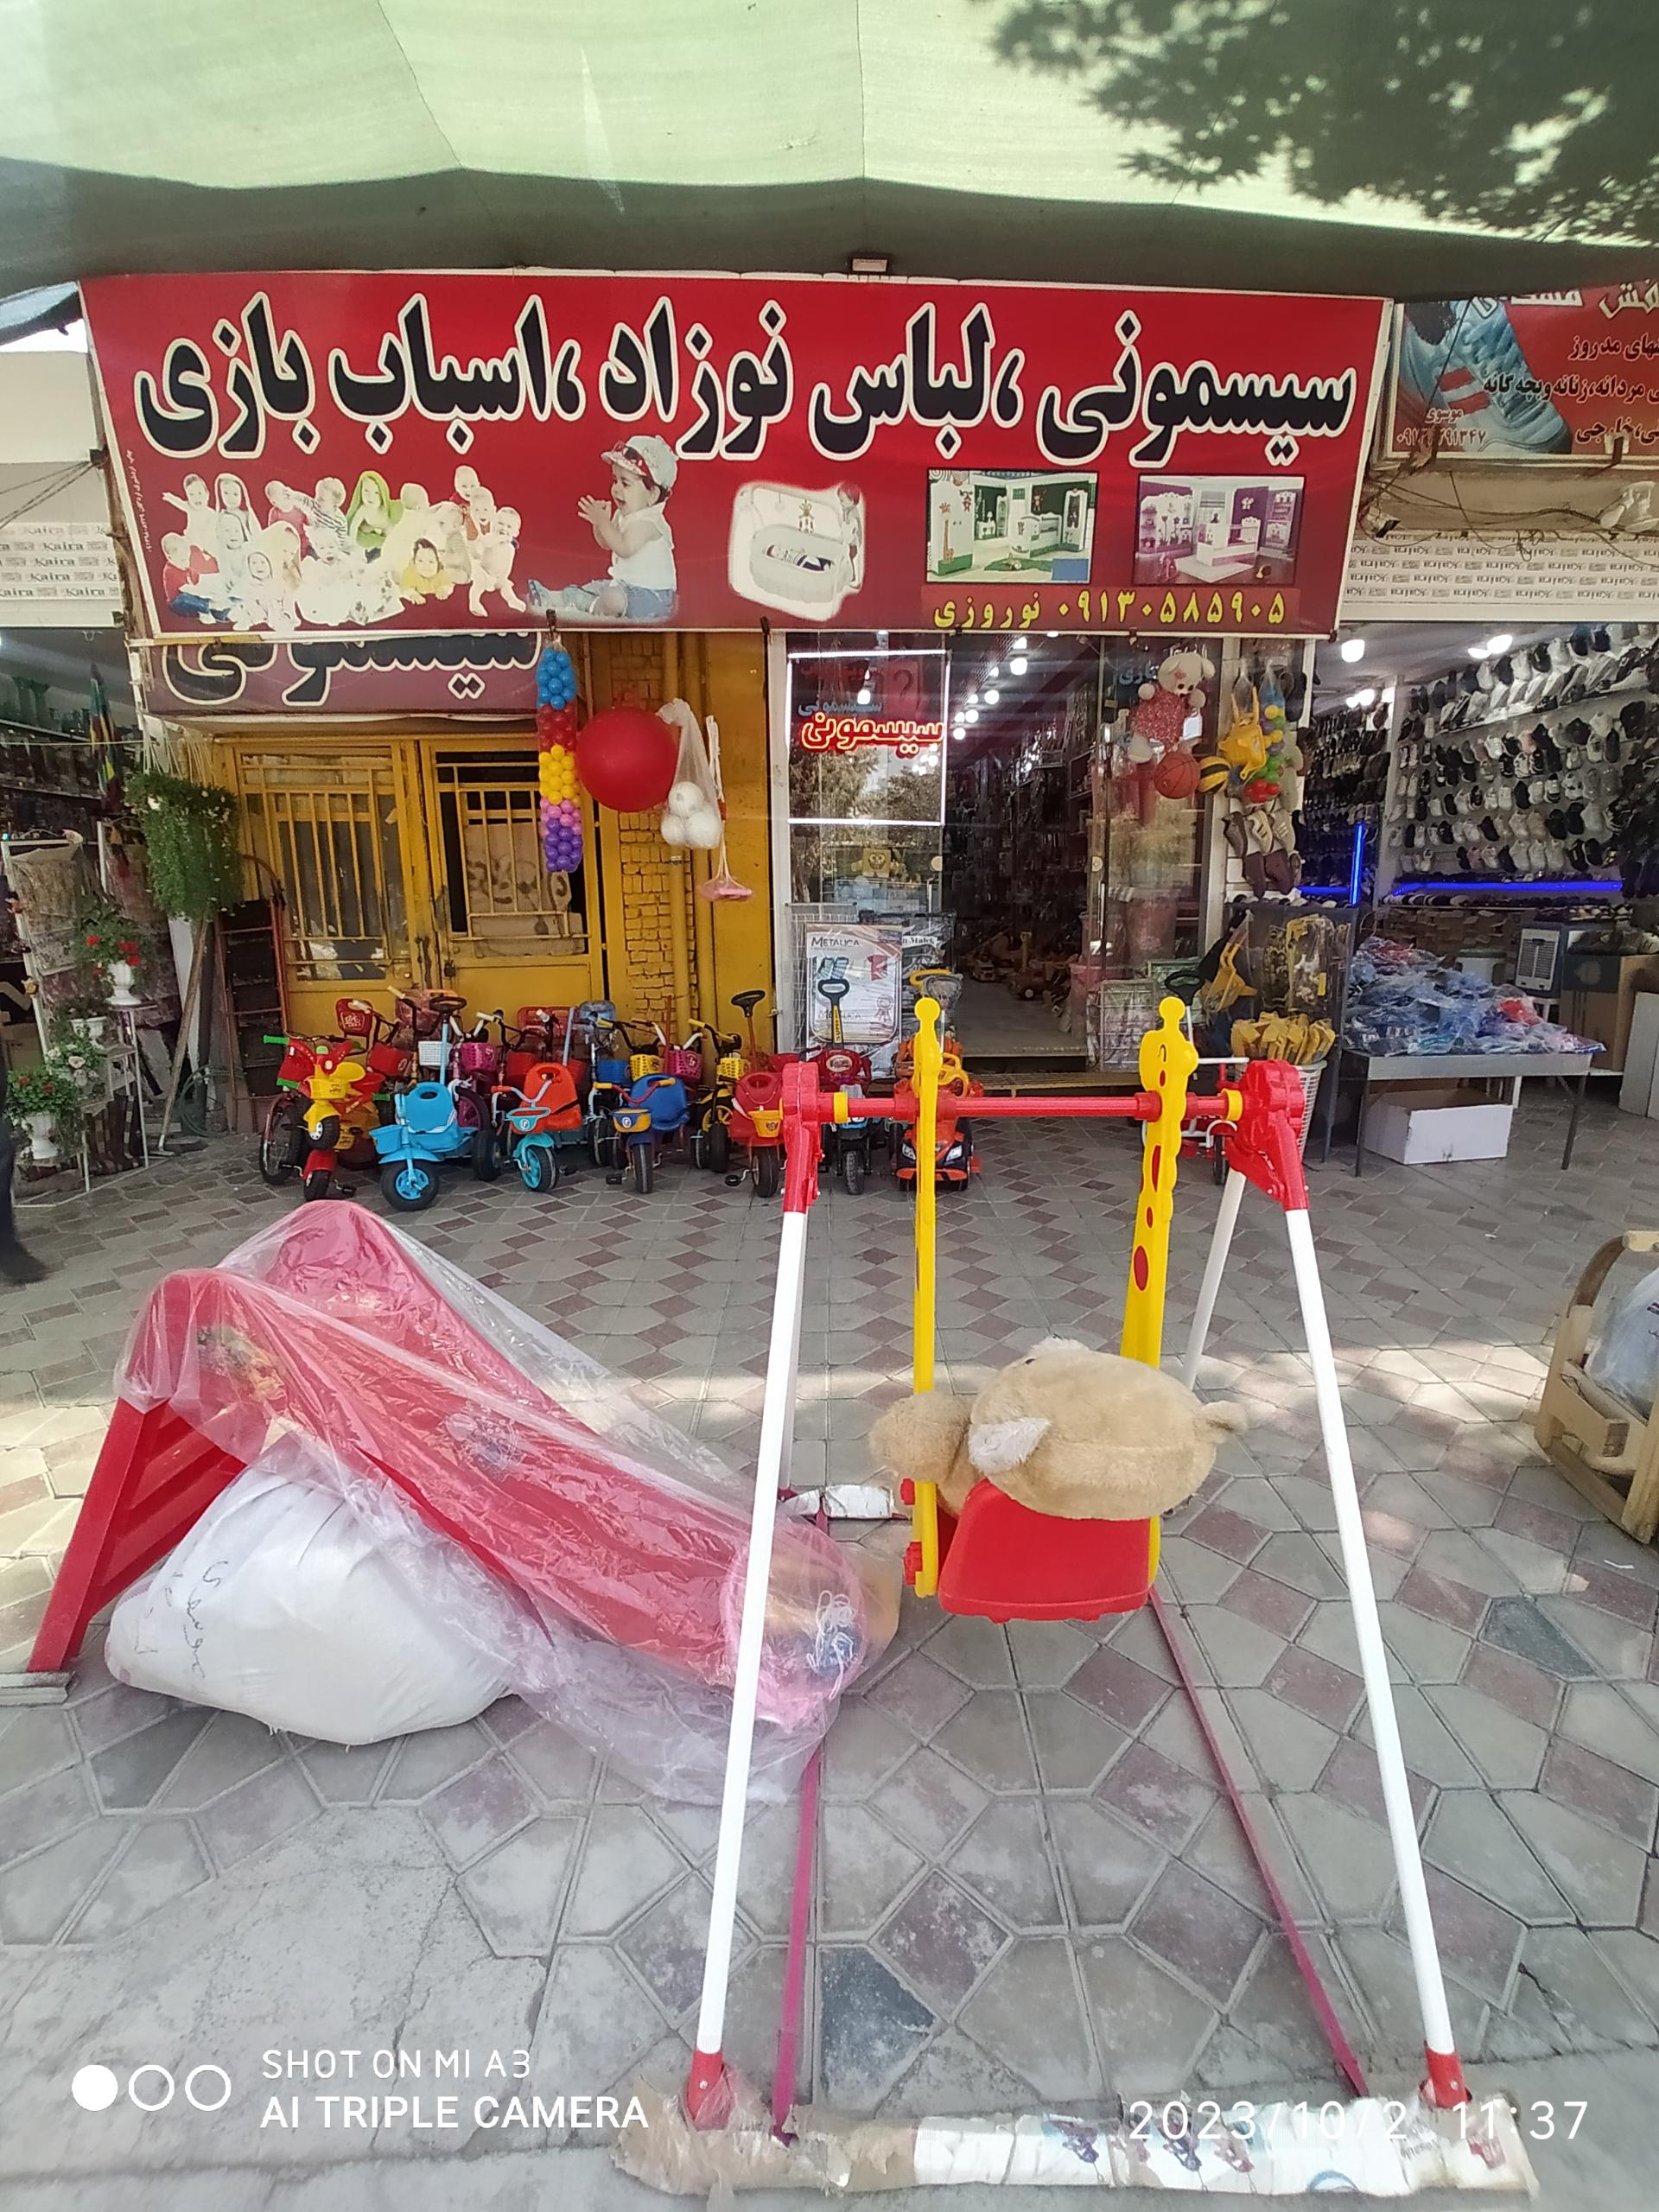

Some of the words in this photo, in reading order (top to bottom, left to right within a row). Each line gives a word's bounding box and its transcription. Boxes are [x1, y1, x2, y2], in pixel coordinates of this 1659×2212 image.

[1599, 278, 1659, 319] فش
[133, 290, 316, 460] بازی
[600, 295, 793, 461] نوزاد
[1037, 310, 1357, 467] سیسمونی
[1424, 408, 1465, 423] موسوی
[35, 557, 75, 567] Kaira
[41, 542, 84, 552] Kaira
[29, 573, 71, 582] Kaira
[65, 588, 105, 597] Kaira
[933, 591, 1040, 629] نوروزی
[1058, 589, 1286, 624] ۰۹۱۳۰۵۸۵۹۰۵
[800, 711, 944, 756] سیسمونی
